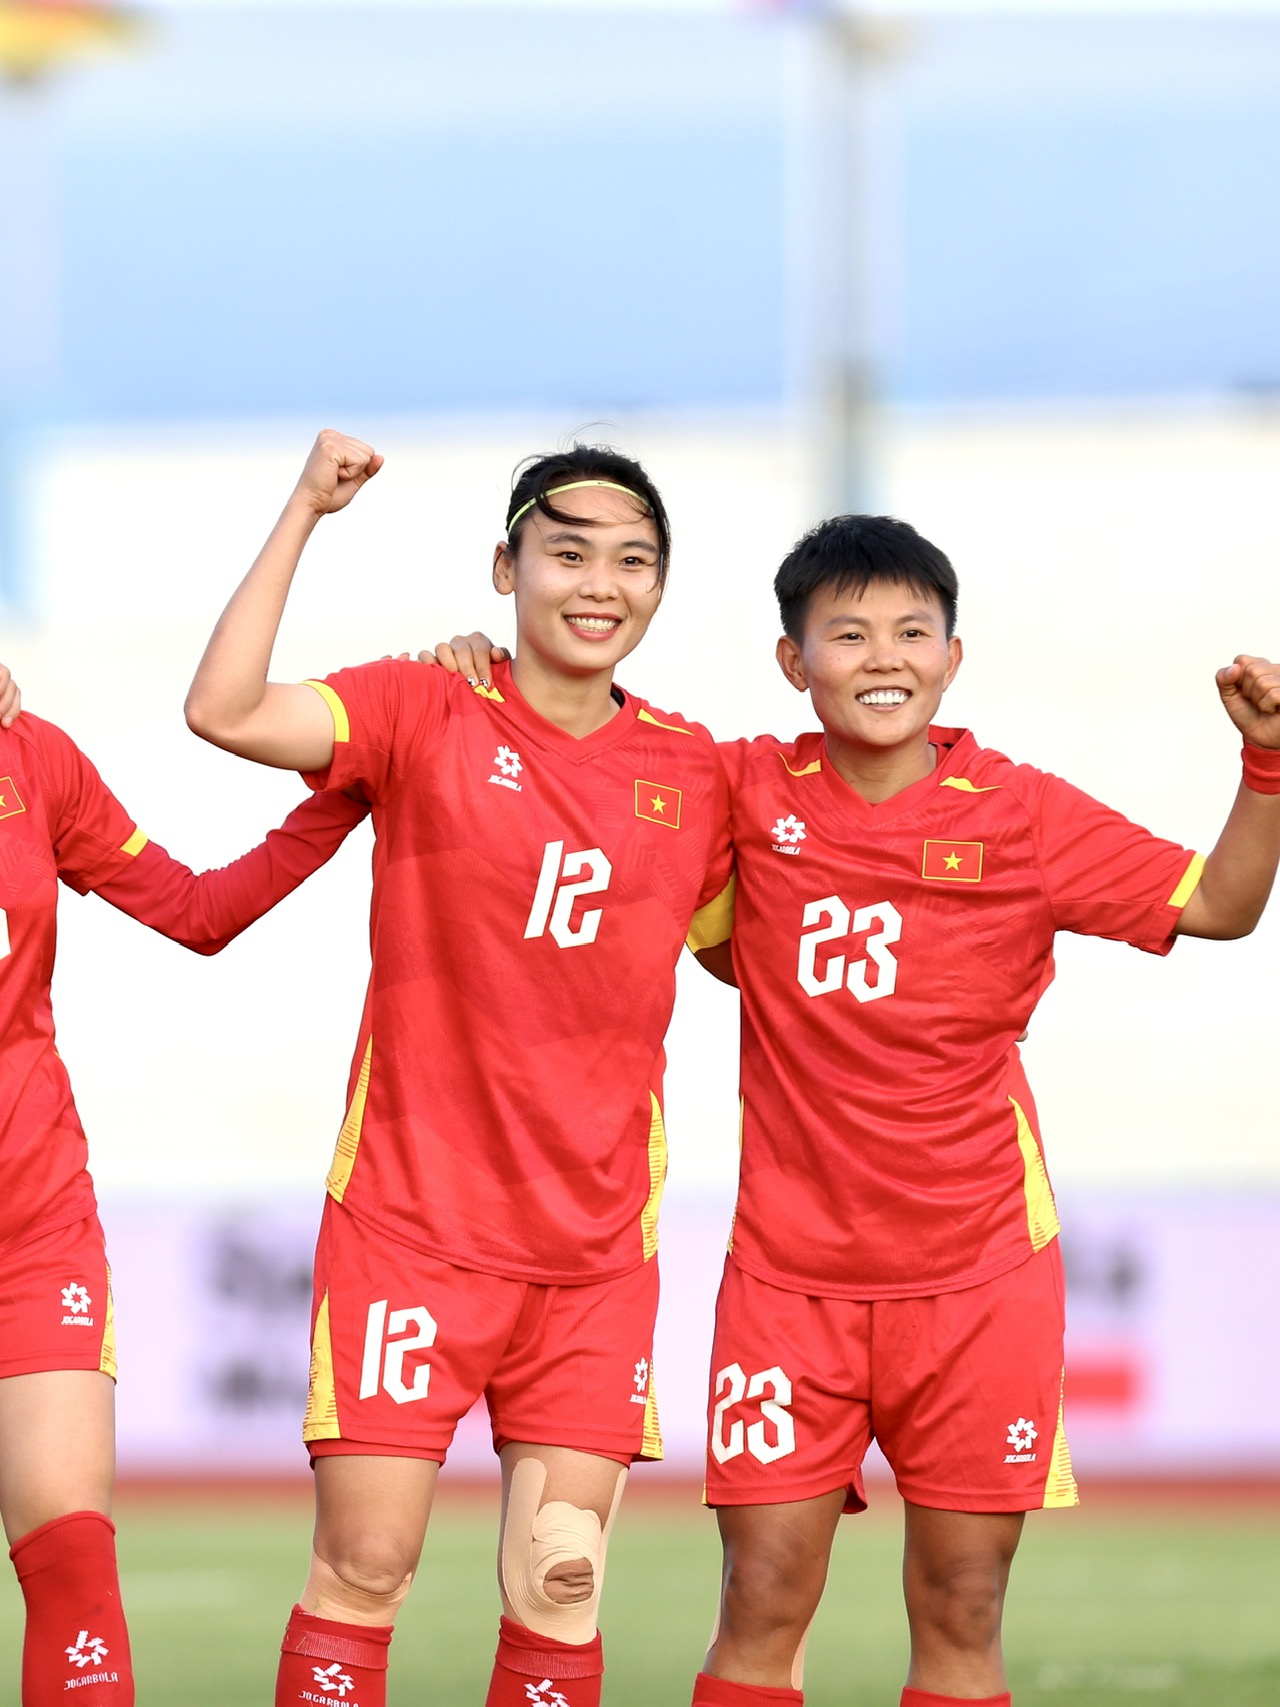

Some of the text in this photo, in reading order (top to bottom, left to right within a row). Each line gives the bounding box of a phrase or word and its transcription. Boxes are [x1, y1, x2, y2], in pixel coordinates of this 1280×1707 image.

[524, 840, 612, 948] 12
[797, 895, 903, 1004] 23
[359, 1299, 437, 1405] 12
[712, 1362, 796, 1465] 23
[64, 1672, 119, 1691] JOGARBOLA
